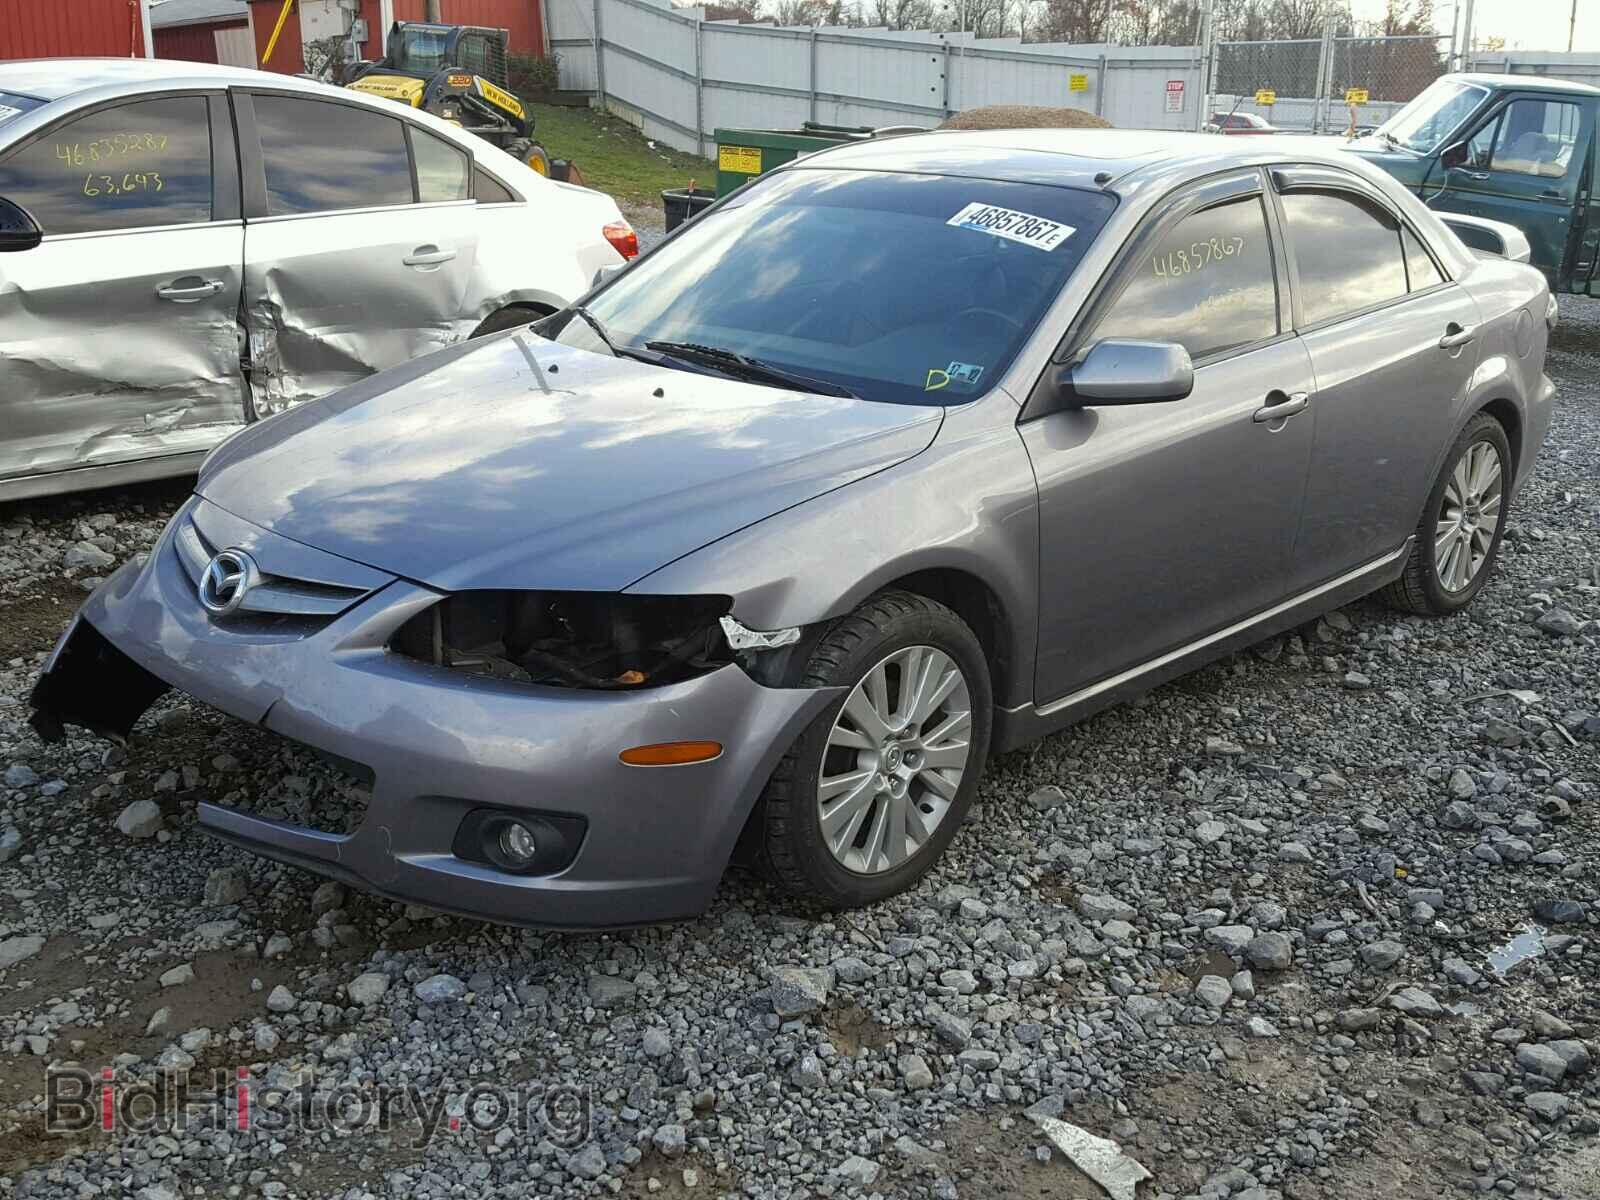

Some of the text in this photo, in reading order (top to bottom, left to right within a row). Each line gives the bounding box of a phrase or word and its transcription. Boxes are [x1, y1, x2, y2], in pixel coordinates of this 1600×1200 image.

[1167, 82, 1184, 91] STOP
[968, 206, 1060, 241] 46857867
[1153, 237, 1244, 285] 46857867
[924, 368, 950, 391] D
